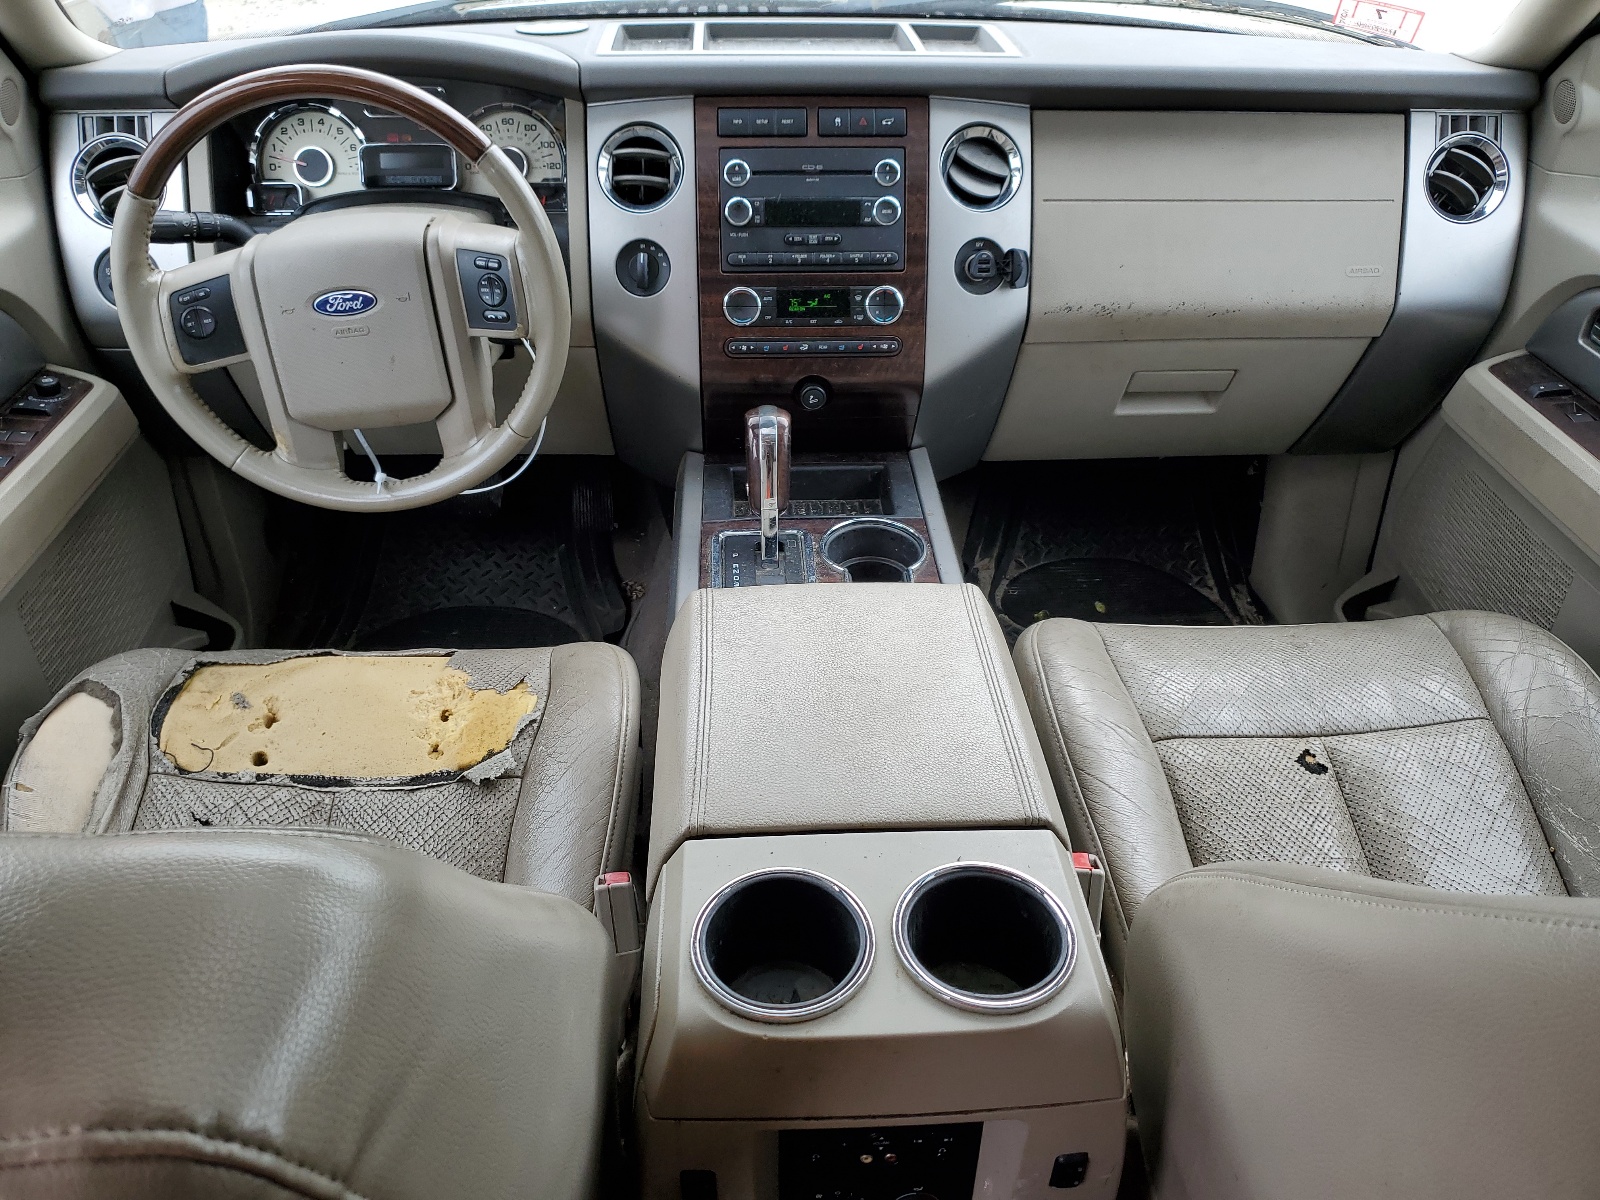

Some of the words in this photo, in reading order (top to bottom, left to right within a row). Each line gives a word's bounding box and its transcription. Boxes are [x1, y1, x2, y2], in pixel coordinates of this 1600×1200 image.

[297, 118, 305, 126] 3
[317, 118, 325, 126] 4
[501, 118, 515, 126] 60
[280, 127, 288, 135] 2
[336, 127, 344, 135] 5
[480, 124, 492, 132] 40
[272, 144, 276, 152] 1
[349, 144, 357, 152] 6
[540, 141, 555, 149] 100
[269, 163, 277, 171] 0
[465, 163, 472, 171] 0
[326, 294, 363, 312] Ford
